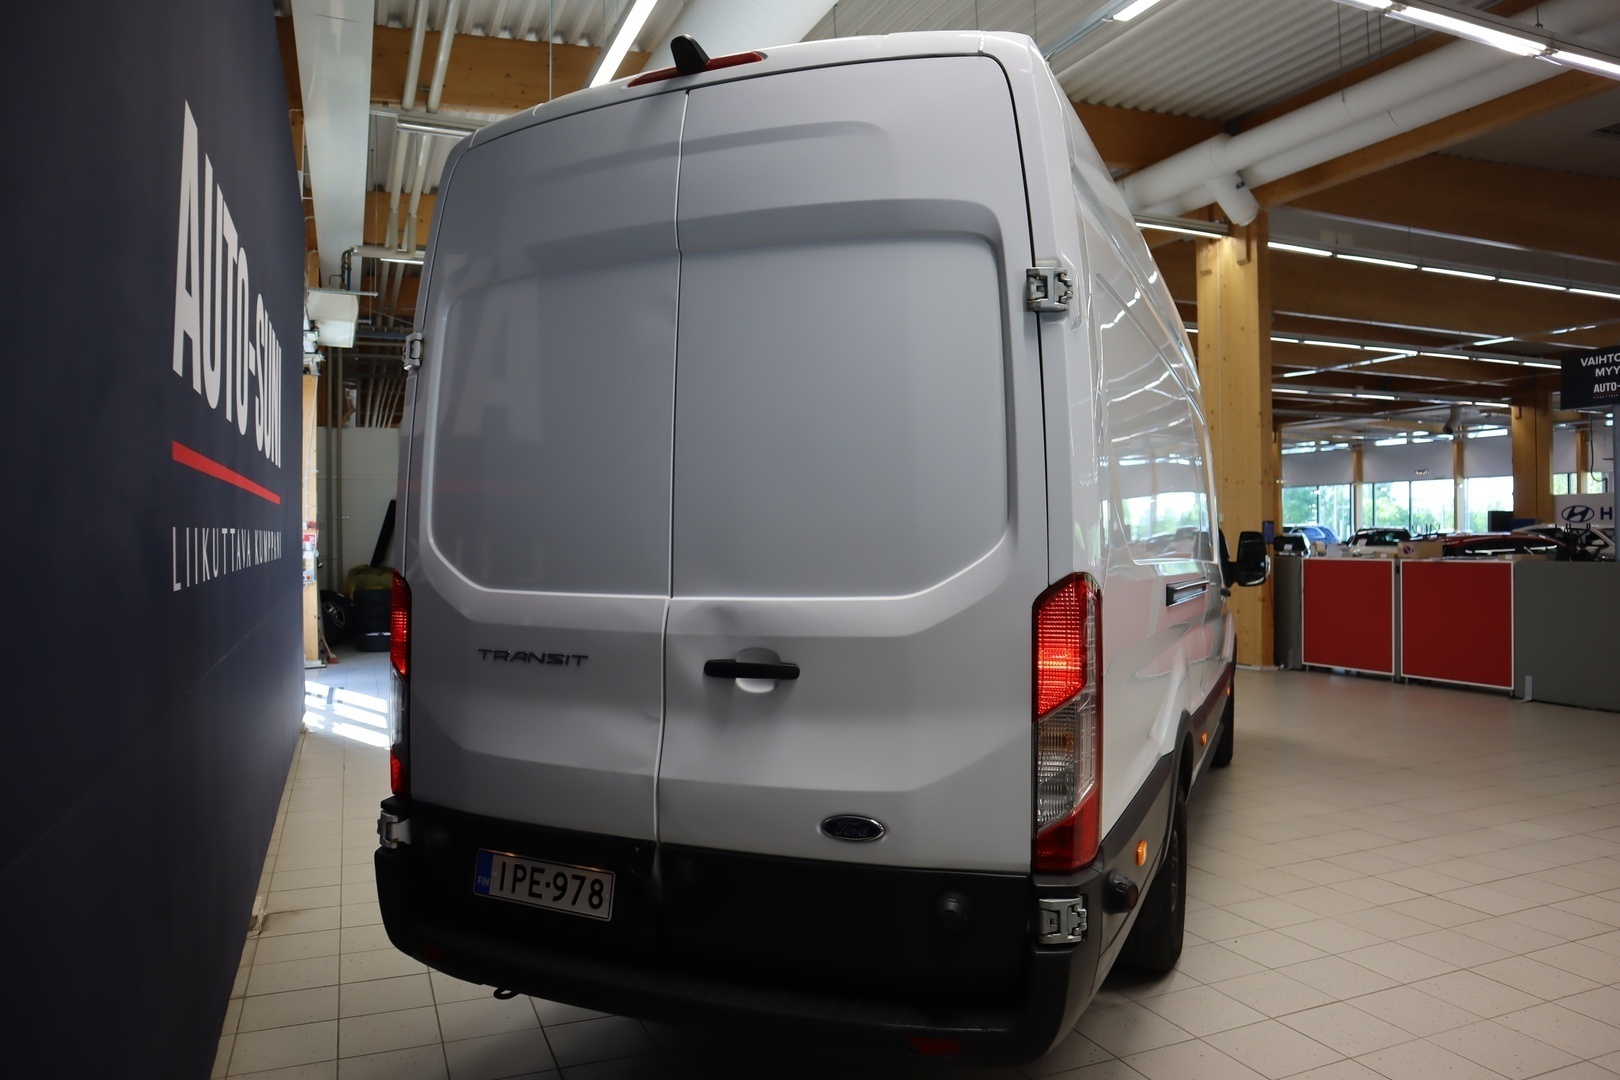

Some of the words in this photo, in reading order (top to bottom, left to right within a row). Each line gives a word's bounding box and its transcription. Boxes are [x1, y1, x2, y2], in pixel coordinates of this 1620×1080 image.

[172, 99, 282, 469] AUTO-SUNI
[172, 526, 252, 592] LIIKUTTAVA
[254, 529, 282, 566] KUMPPANI
[477, 648, 589, 667] TRANSIT
[834, 821, 870, 838] Ford
[476, 876, 490, 887] FIN
[499, 861, 605, 911] IPE-978
